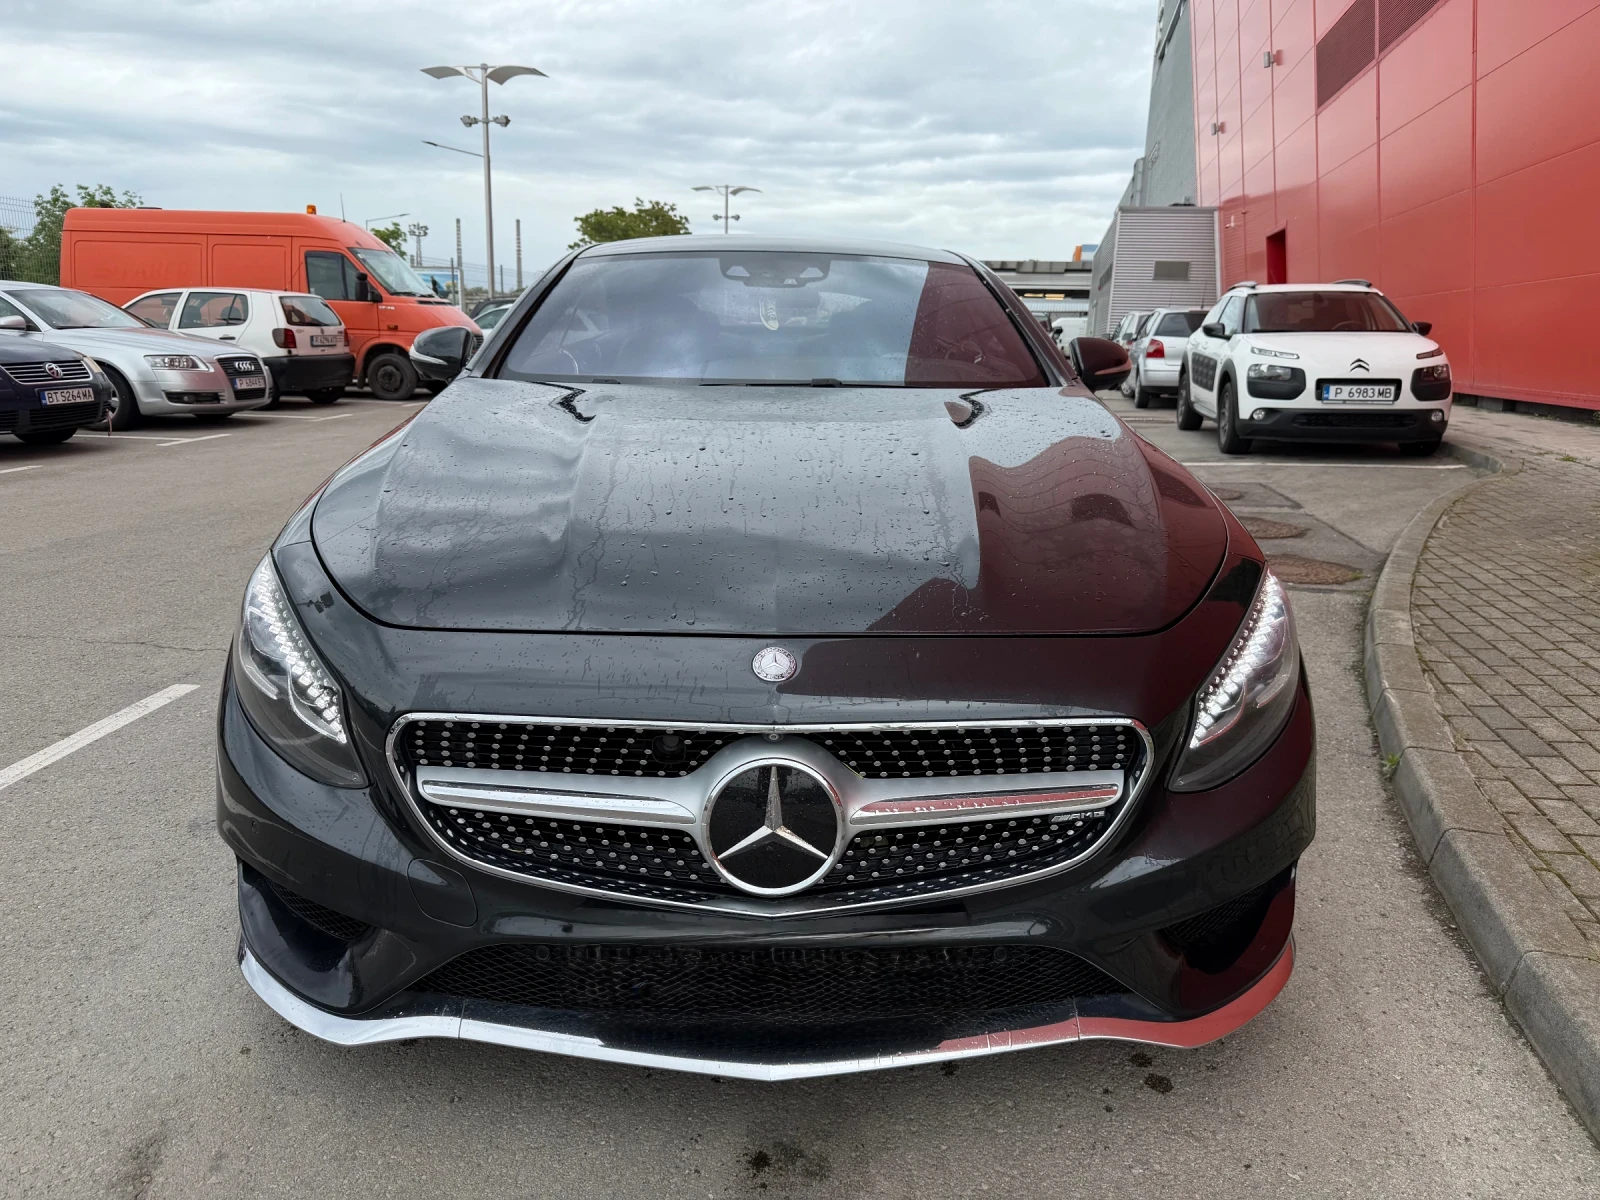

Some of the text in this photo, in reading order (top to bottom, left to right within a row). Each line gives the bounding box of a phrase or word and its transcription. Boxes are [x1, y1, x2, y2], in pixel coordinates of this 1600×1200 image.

[46, 389, 93, 403] BT 5264 MA
[1334, 387, 1392, 398] P 6983 MB
